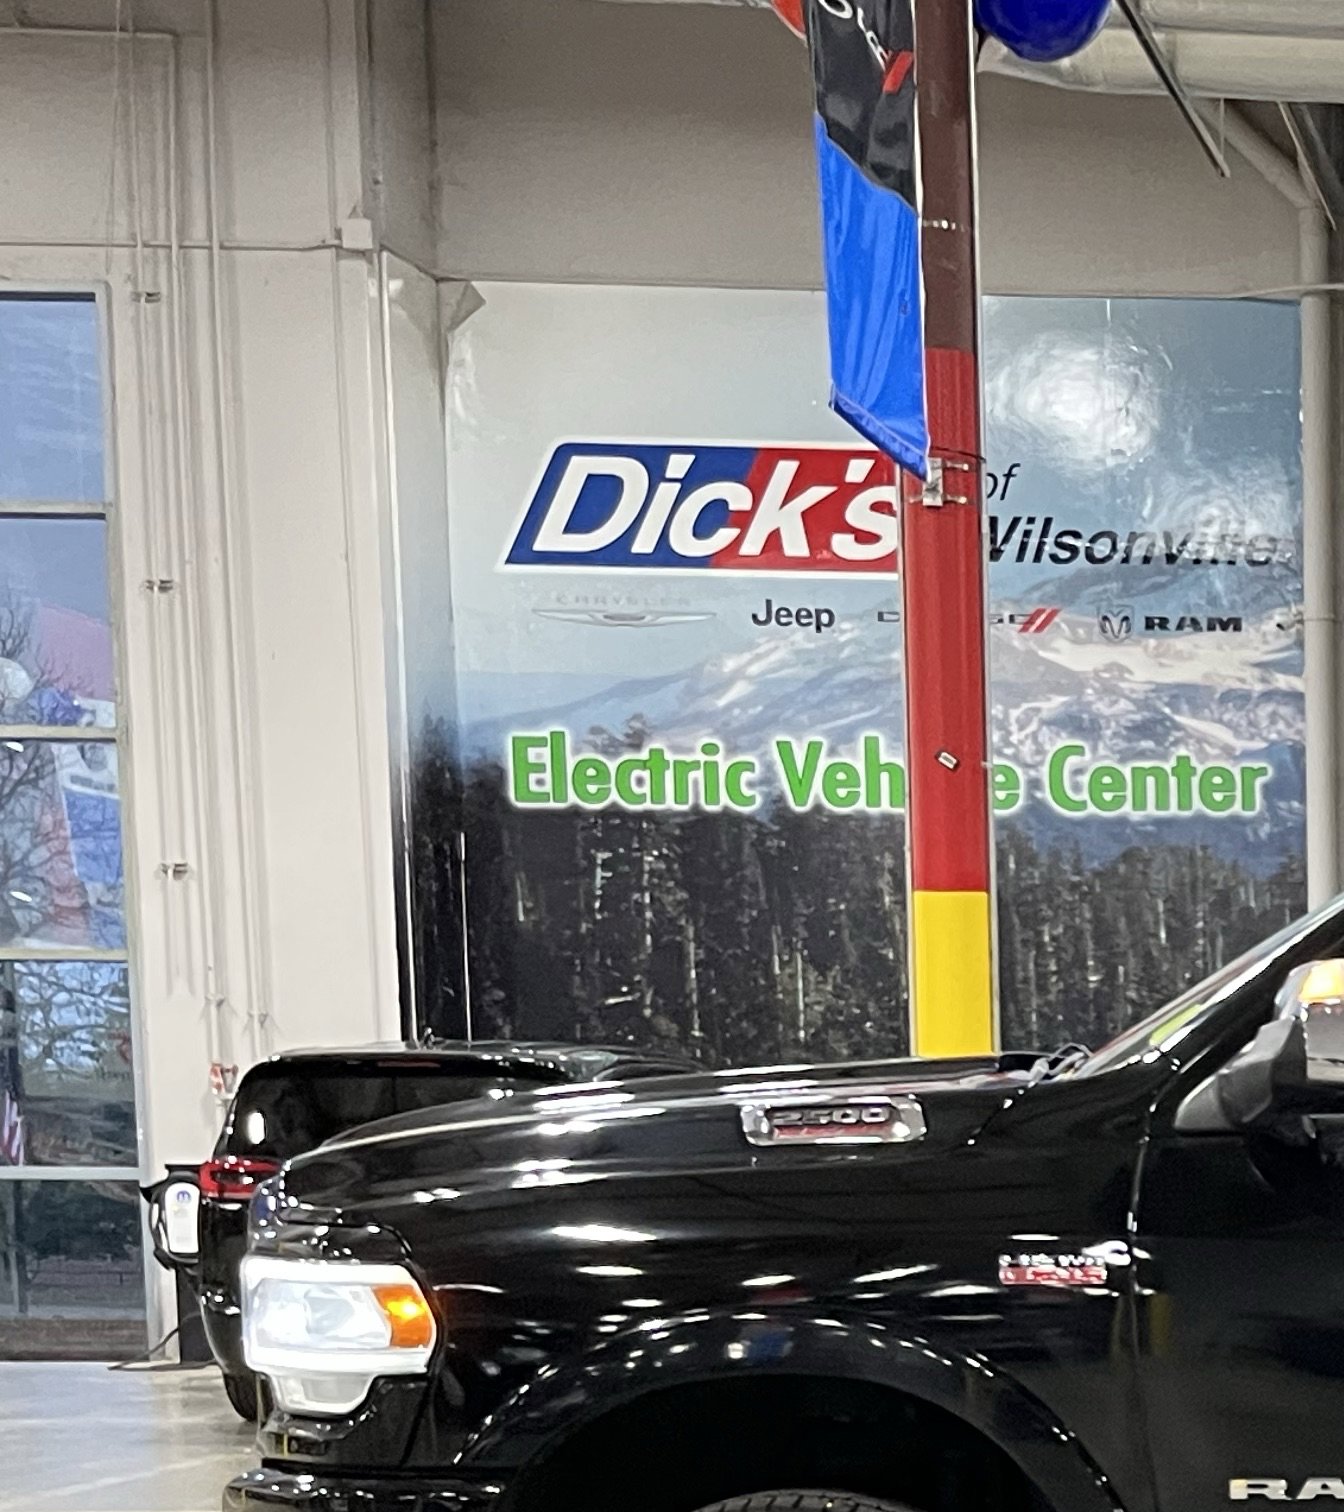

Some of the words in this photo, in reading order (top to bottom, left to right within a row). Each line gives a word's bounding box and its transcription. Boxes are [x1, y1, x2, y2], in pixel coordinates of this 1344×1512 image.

[532, 454, 899, 560] Dick's
[752, 599, 835, 633] Jeep
[1144, 616, 1242, 632] RAM
[512, 731, 756, 806] Electric
[776, 736, 1020, 811] Vehe
[1049, 745, 1267, 812] Center
[772, 1107, 890, 1126] 2500
